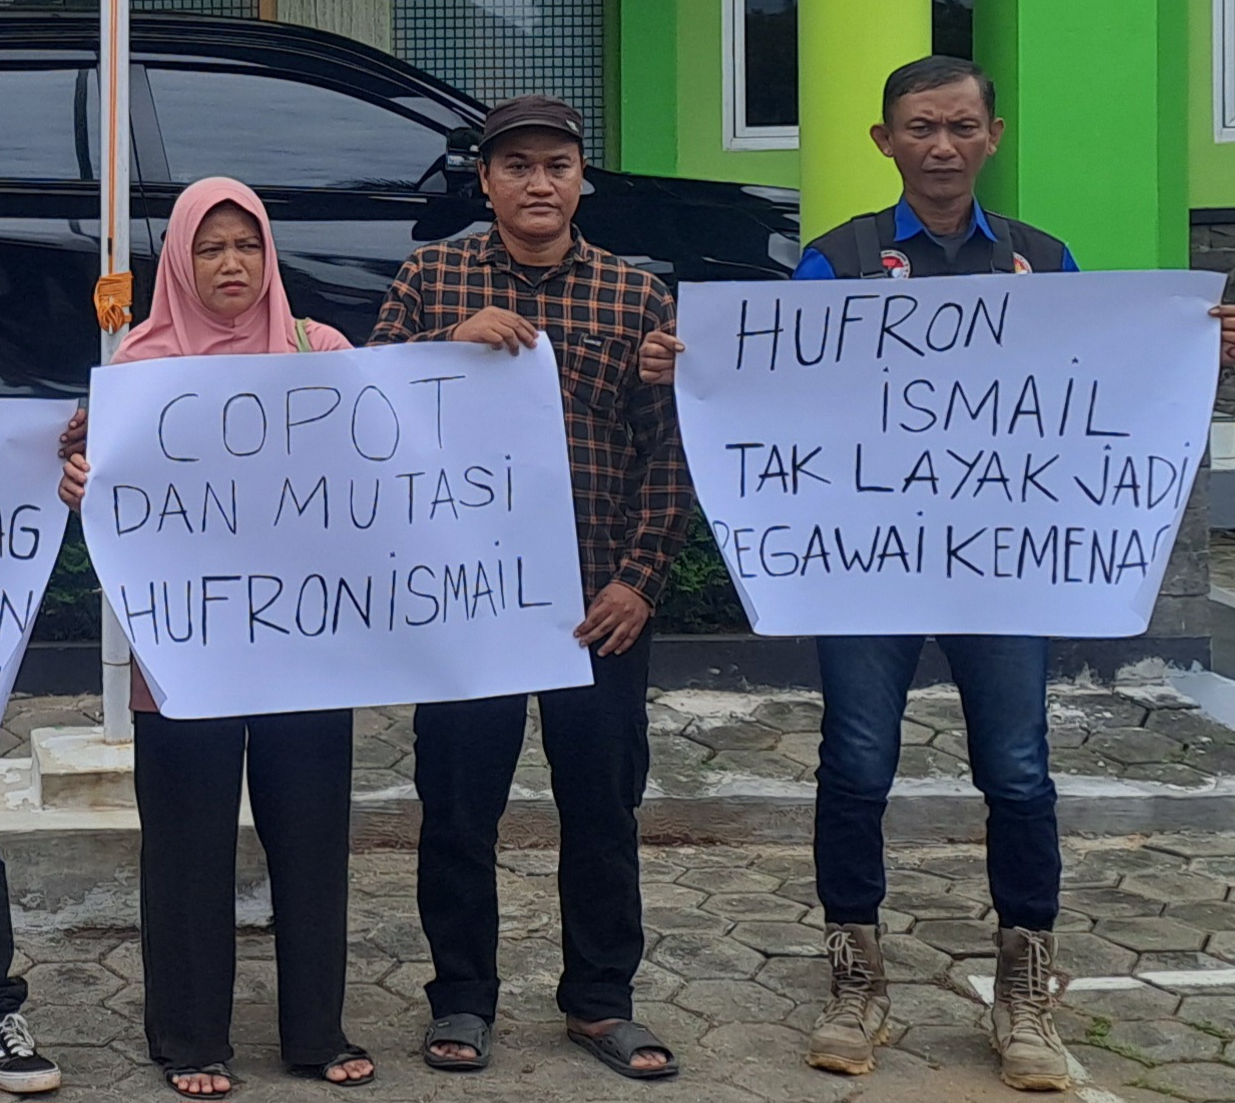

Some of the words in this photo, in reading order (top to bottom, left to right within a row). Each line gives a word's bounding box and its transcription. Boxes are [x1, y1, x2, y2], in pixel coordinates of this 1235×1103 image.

[735, 292, 1010, 371] HUFRON
[158, 375, 466, 462] COPOT
[112, 480, 238, 536] DAN
[274, 454, 514, 530] MUTASI
[724, 443, 832, 498] TAK
[855, 443, 1061, 503] LAYAK
[120, 573, 372, 646] HUFRON
